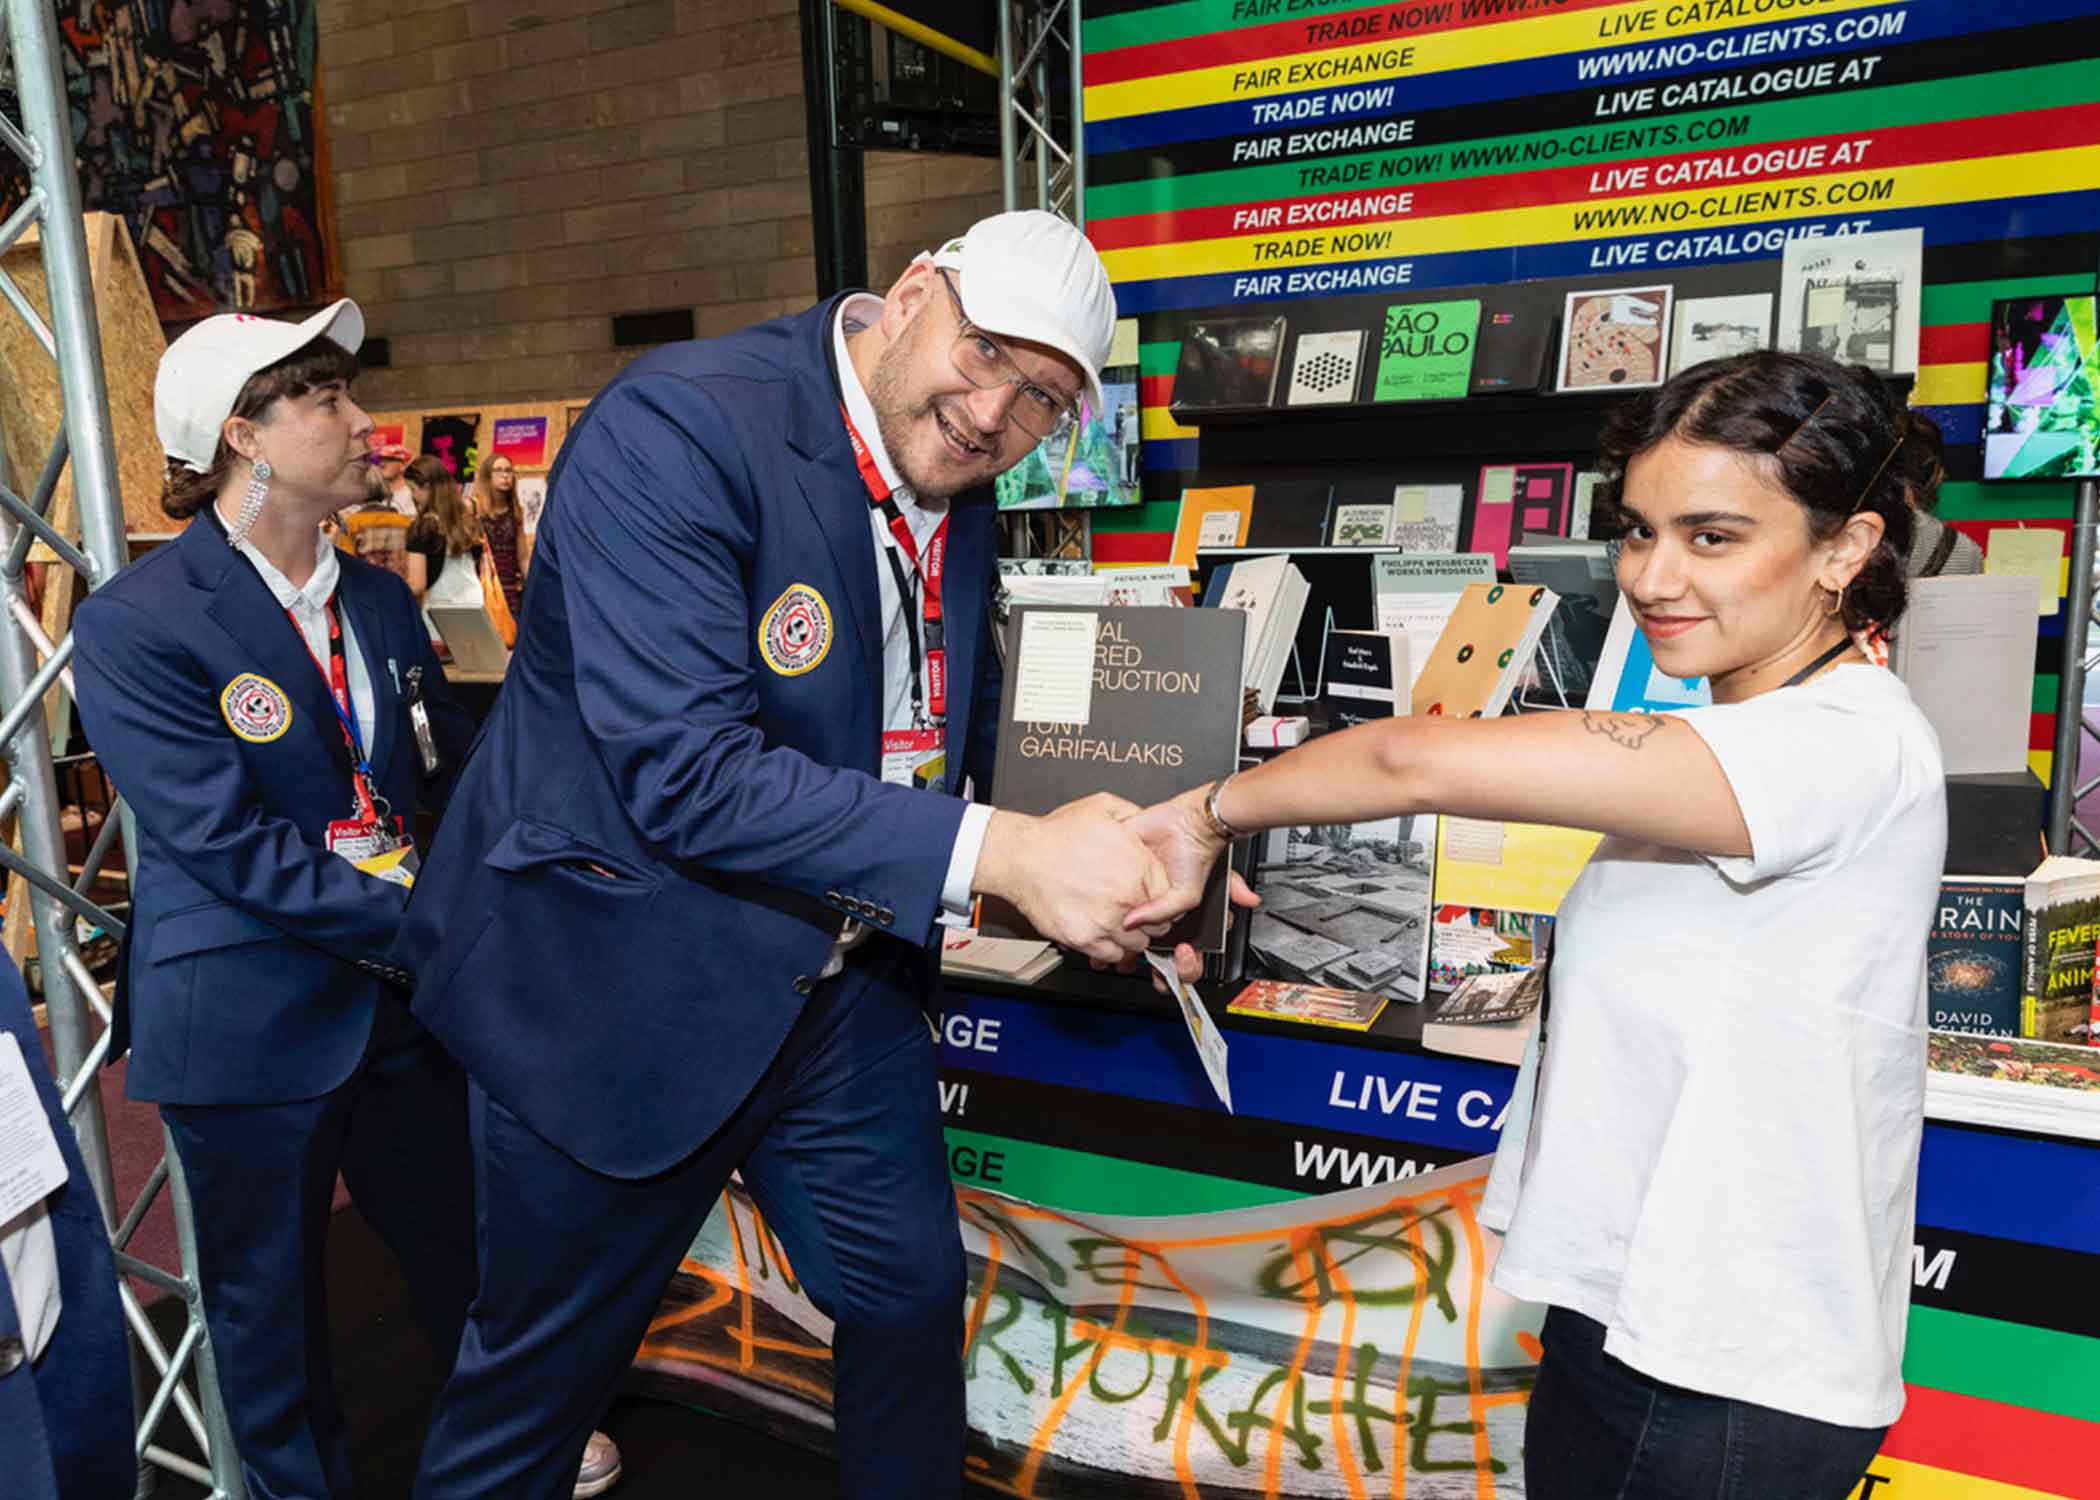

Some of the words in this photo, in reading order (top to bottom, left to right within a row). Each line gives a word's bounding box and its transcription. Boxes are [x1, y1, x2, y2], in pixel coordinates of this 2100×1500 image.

[1233, 0, 1280, 20] FAIR
[1306, 14, 1382, 44] TRADE
[1388, 3, 1454, 31] NOW!
[1599, 10, 1657, 37] LIVE
[1665, 0, 1836, 26] CATALOG
[1578, 11, 1907, 80] WWW.NO-CLIENTS.COM
[1233, 68, 1280, 92] FAIR
[1287, 48, 1415, 84] EXCHANGE
[1595, 86, 1655, 116] LIVE
[1661, 63, 1835, 111] CATALOGUE
[1837, 56, 1882, 83] AT
[1252, 96, 1326, 125] TRADE
[1331, 86, 1395, 114] NOW!
[1233, 137, 1280, 162] FAIR
[1286, 120, 1415, 156] EXCHANGE
[1299, 161, 1373, 189] TRADE
[1378, 153, 1442, 177] NOW!
[1450, 115, 1751, 170] WWW.NO-CLIENTS.COM
[1589, 167, 1649, 194] LIVE
[1655, 145, 1827, 188] CATALOGUE
[1830, 140, 1872, 165] AT
[1233, 205, 1280, 230] FAIR
[1286, 192, 1414, 226] EXCHANGE
[1574, 178, 1896, 231] WWW.NO-CLIENTS.COM
[1253, 235, 1324, 262] TRADE
[1330, 231, 1392, 254] NOW!
[1590, 243, 1649, 268] LIVE
[1233, 274, 1281, 297] FAIR
[1286, 263, 1414, 294] EXCHANGE
[1384, 309, 1440, 336] SÃO
[1382, 332, 1470, 359] PAULO
[1092, 670, 1200, 694] RUCTION
[1020, 736, 1184, 767] GARIFALAKIS
[1957, 895, 1984, 906] THE
[1939, 907, 2021, 931] RAIN
[2048, 924, 2100, 949] FEVER
[2047, 969, 2094, 992] ANIM
[1935, 1010, 1992, 1025] DAVID
[1328, 1071, 1442, 1122] LIVE
